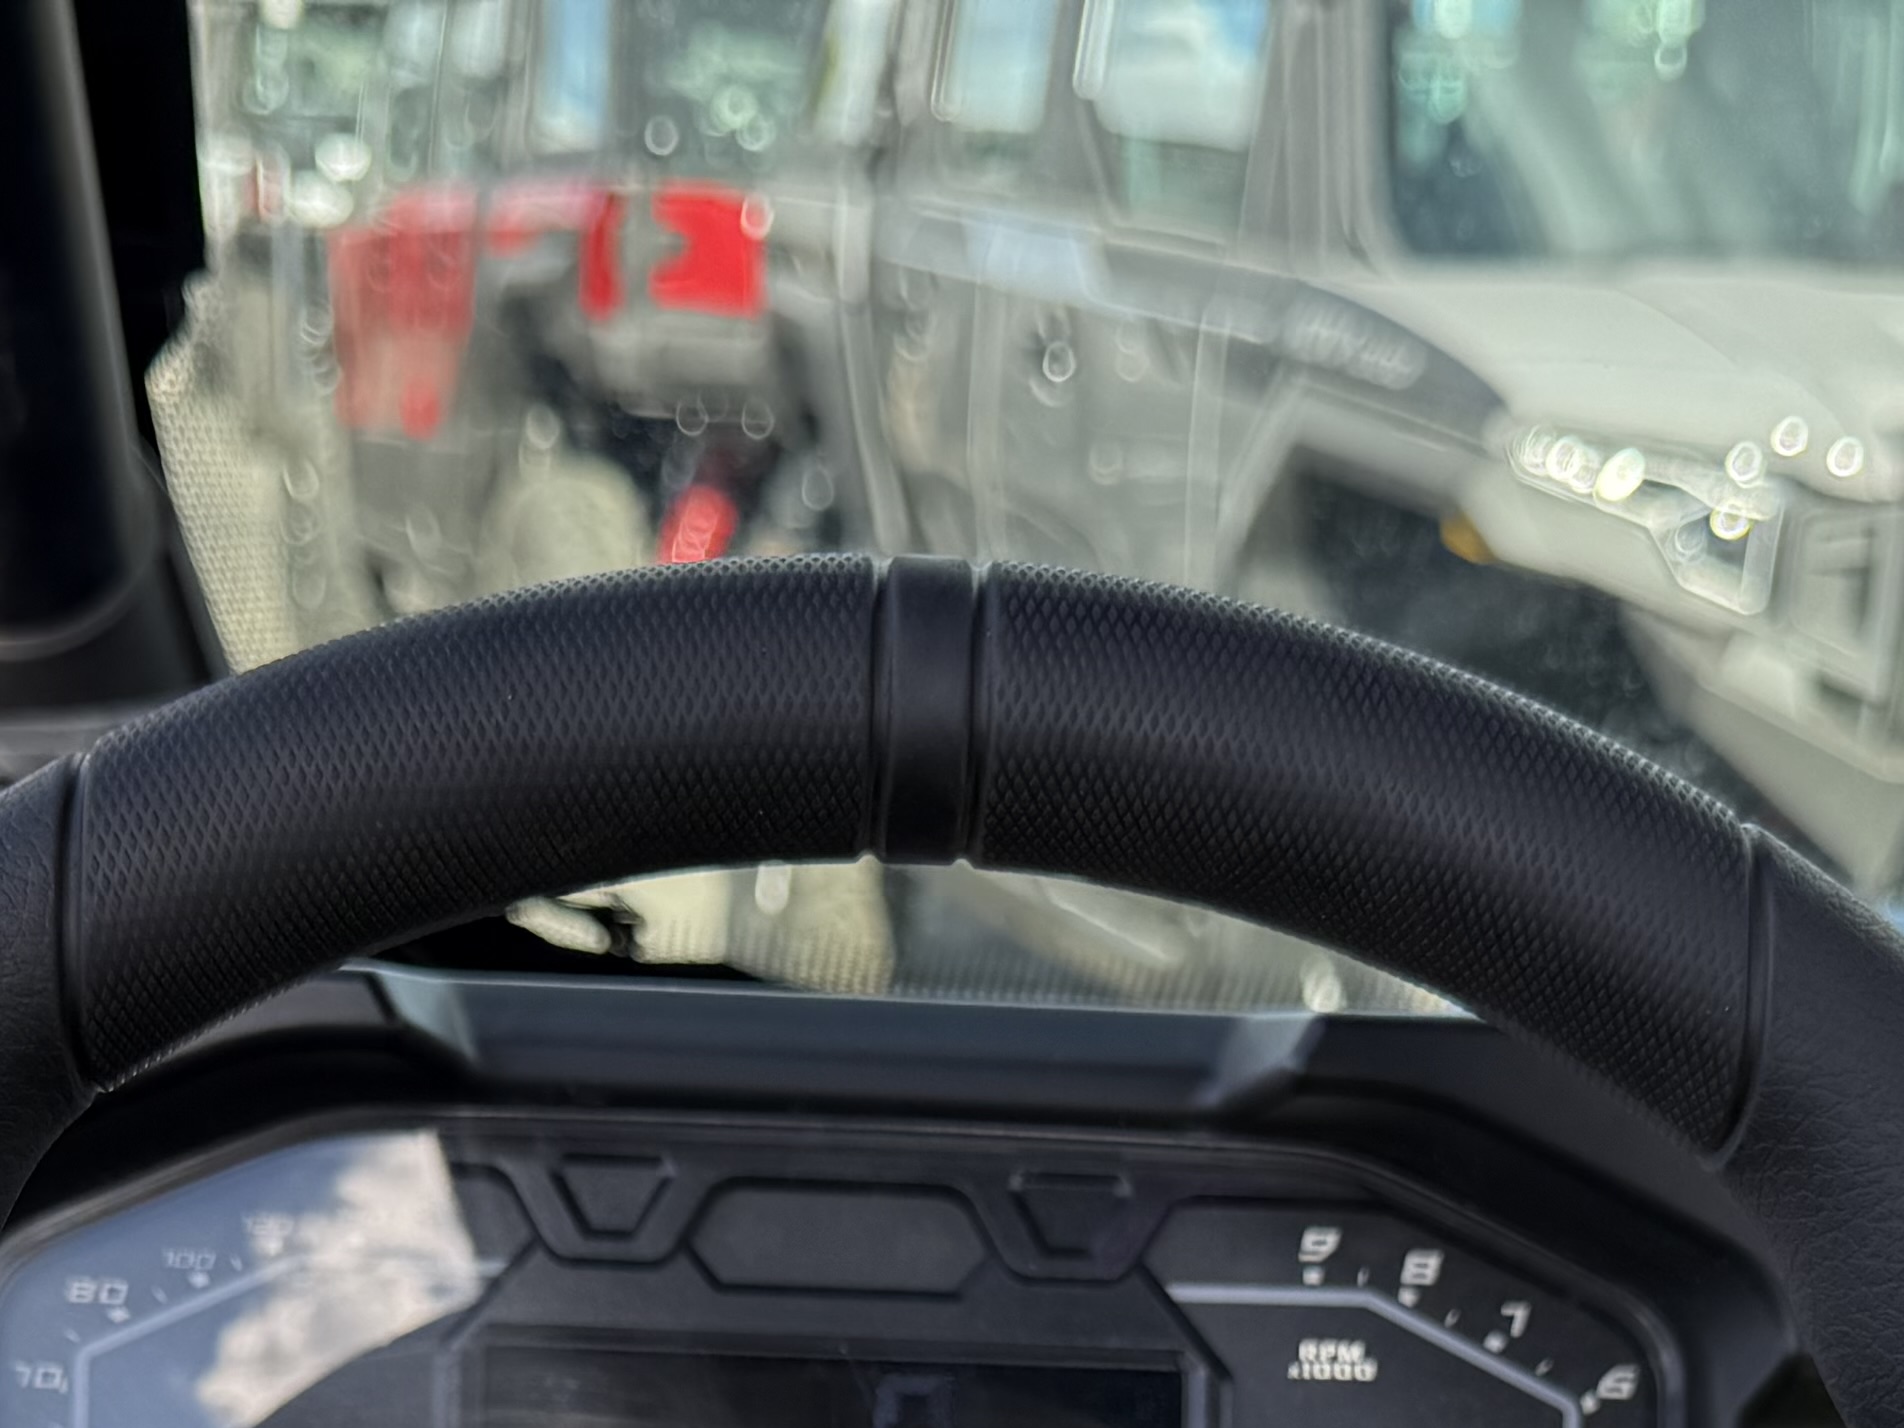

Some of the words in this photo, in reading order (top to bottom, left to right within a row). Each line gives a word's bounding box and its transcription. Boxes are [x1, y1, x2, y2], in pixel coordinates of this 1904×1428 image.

[1298, 1226, 1342, 1262] 9
[1400, 1249, 1444, 1286] 8
[66, 1277, 129, 1303] 80
[1500, 1300, 1532, 1338] 7
[1298, 1338, 1367, 1361] RPM
[10, 1360, 65, 1390] 70
[1596, 1363, 1641, 1400] 6
